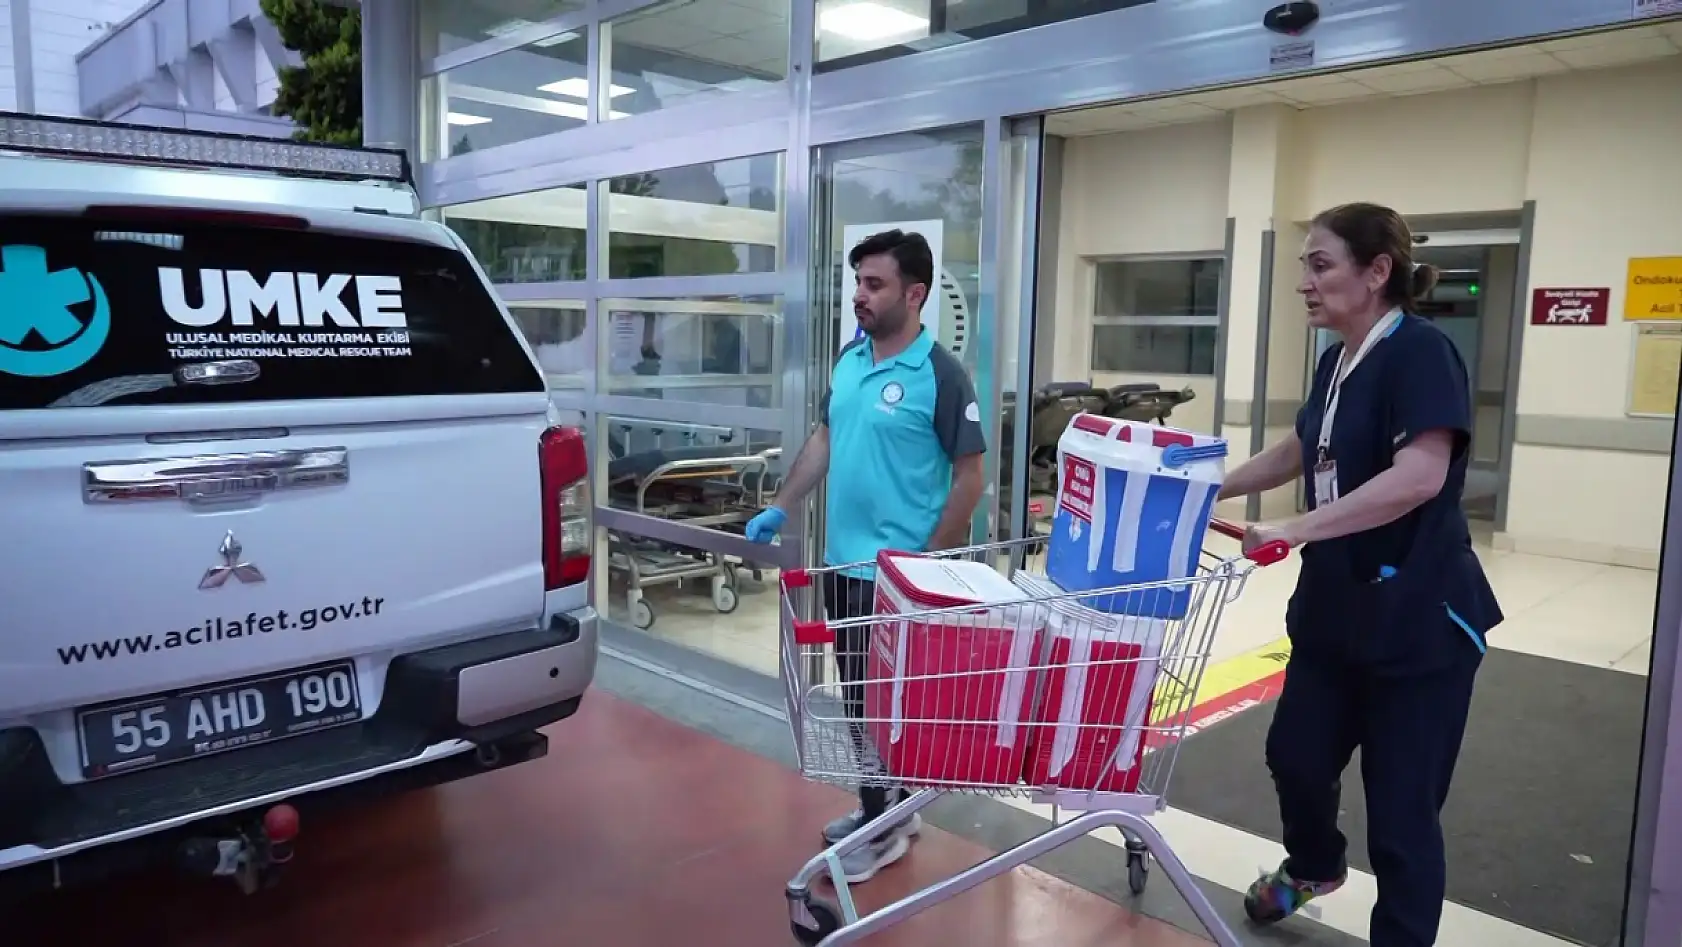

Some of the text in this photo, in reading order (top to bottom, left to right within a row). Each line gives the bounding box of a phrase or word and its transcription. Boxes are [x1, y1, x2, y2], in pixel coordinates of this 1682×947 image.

[158, 266, 407, 327] UMKE
[165, 330, 410, 344] ULUSAL MEDİKAL KURTARMA EKİBİ
[167, 344, 412, 358] TÜRKİYE NATIONAL MEDICAL RESCUE TEAM
[57, 596, 385, 665] www.acilafet.gov.tr
[111, 705, 171, 753] 55
[187, 688, 267, 740] AHD
[286, 671, 351, 717] 190
